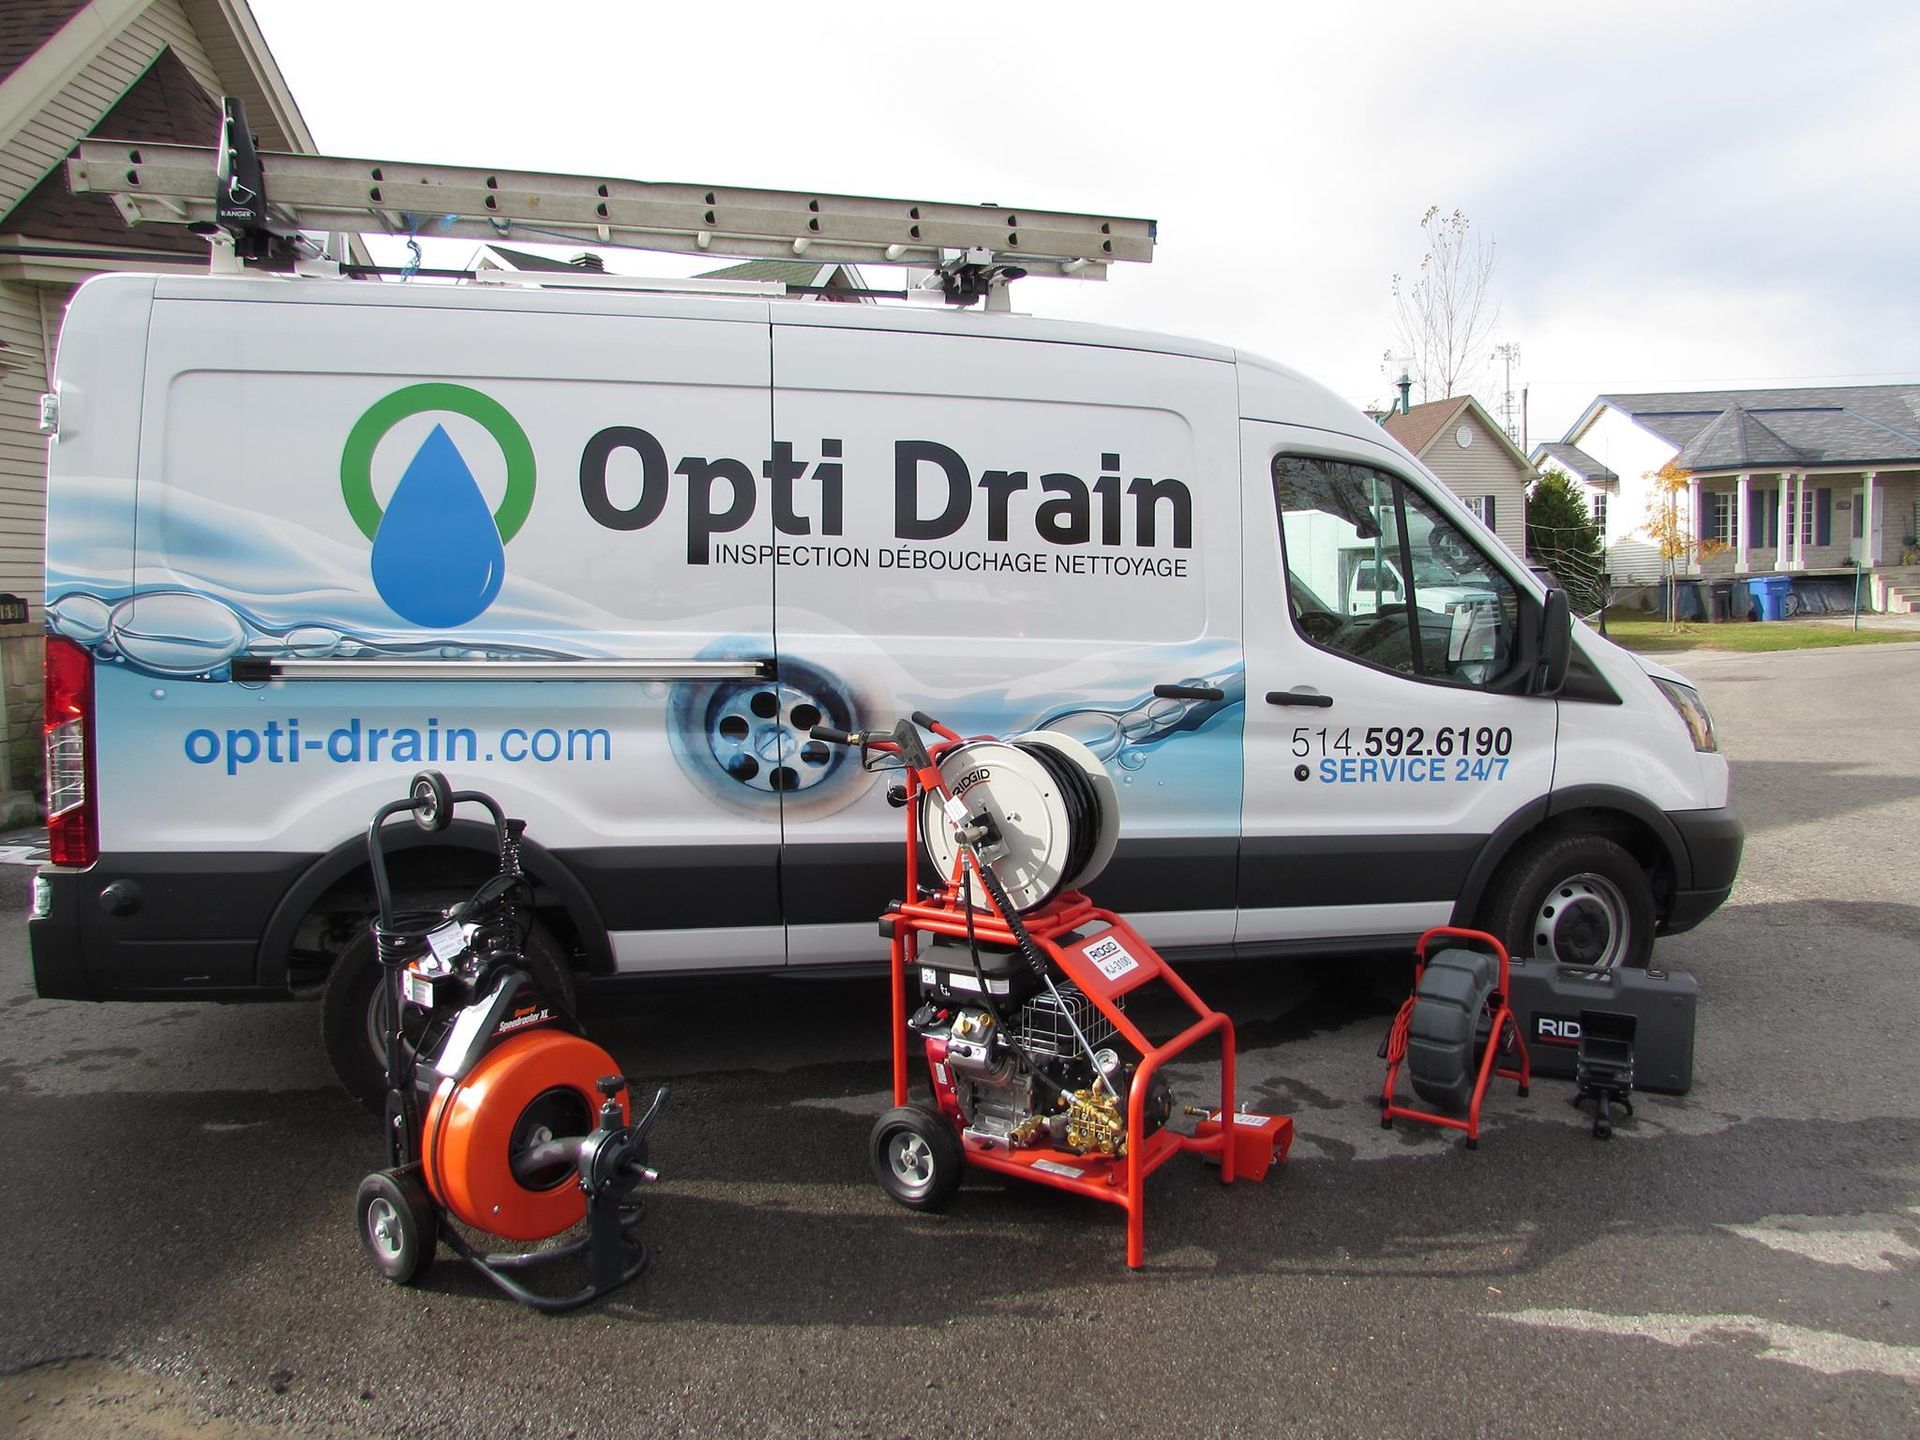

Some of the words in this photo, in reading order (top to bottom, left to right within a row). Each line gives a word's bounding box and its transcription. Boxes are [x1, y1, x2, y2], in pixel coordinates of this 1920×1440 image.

[220, 209, 253, 218] RANGER
[580, 426, 843, 566] Opti
[894, 440, 1192, 549] Drain
[715, 544, 870, 568] INSPECTION
[878, 544, 1048, 574] DÉBOUCHAGE
[1055, 554, 1188, 578] NETTOYAGE
[184, 717, 611, 776] opti-drain.com
[1291, 726, 1513, 757] 514.592.6190
[952, 768, 990, 796] RIDGID
[1318, 757, 1446, 784] SERVICE
[1455, 757, 1510, 782] 24/7
[1089, 941, 1118, 961] RIDGID
[1538, 1017, 1583, 1039] RID
